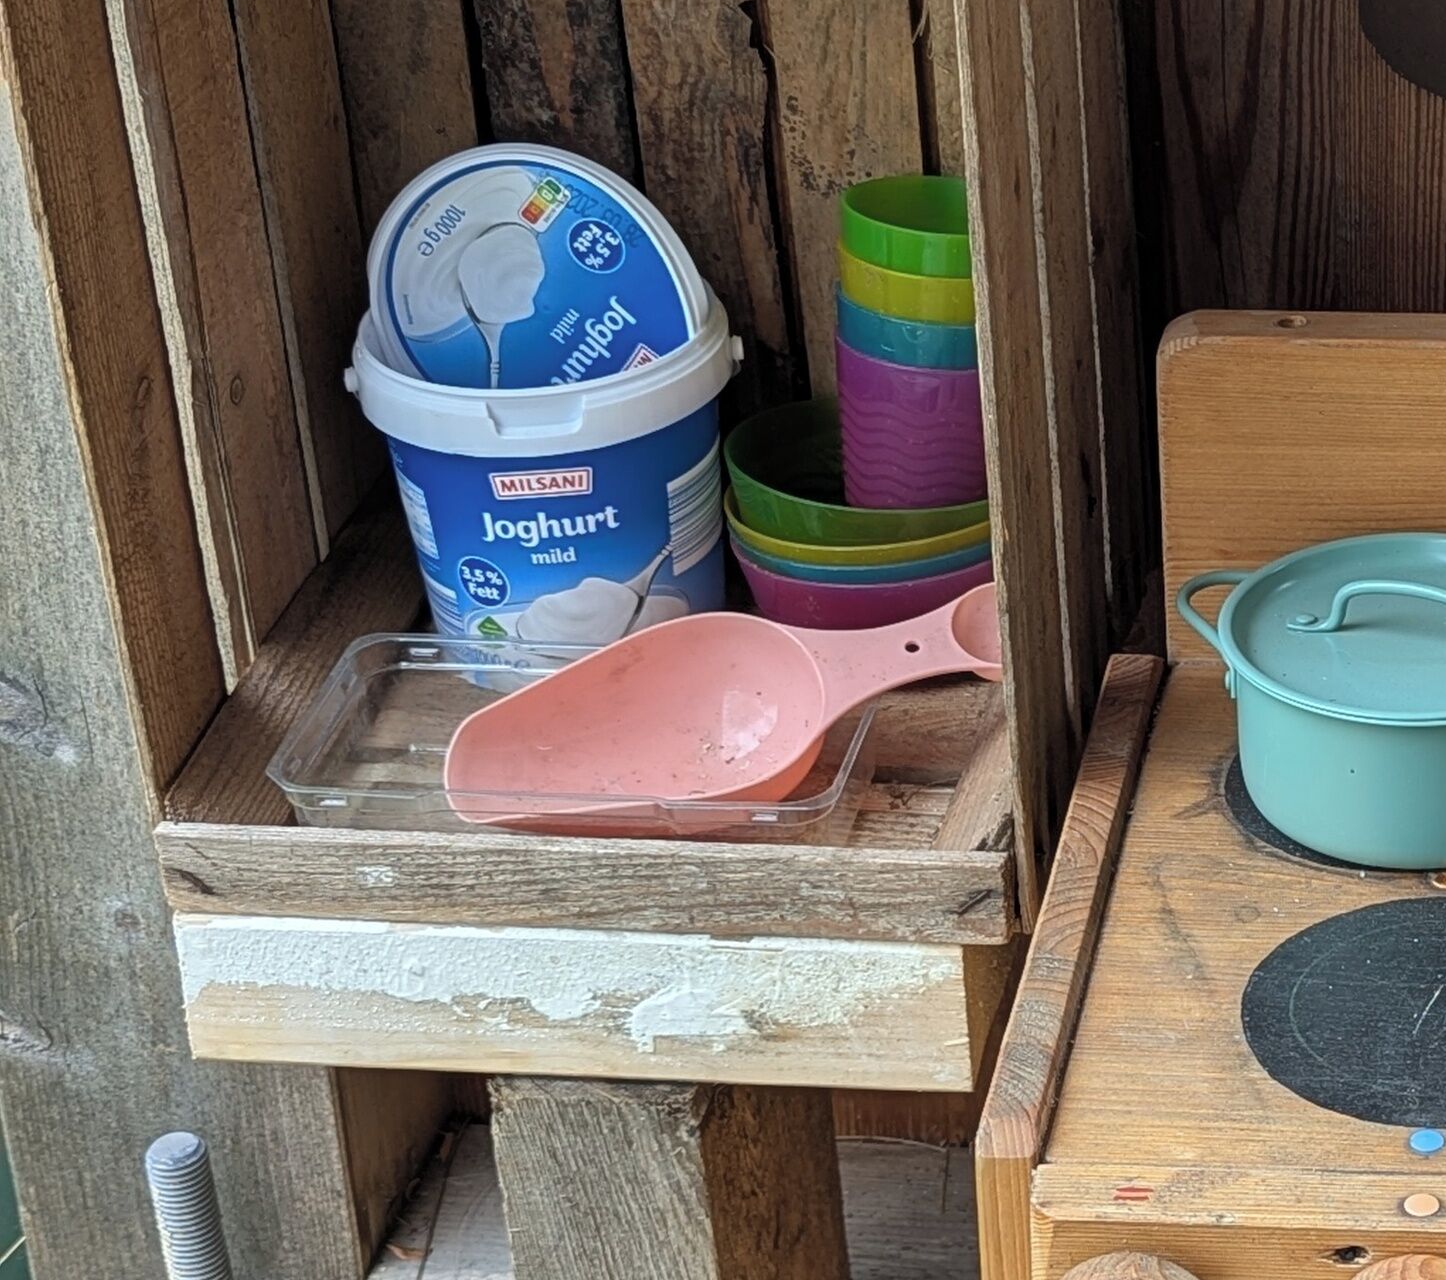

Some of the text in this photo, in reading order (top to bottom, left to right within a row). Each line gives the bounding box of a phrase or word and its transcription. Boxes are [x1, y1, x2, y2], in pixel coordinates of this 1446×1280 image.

[434, 204, 466, 235] 1000
[572, 223, 603, 253] Fett
[550, 308, 581, 344] mild
[500, 474, 584, 493] MILSANI
[482, 505, 620, 548] Joghurt
[530, 546, 577, 565] mild
[467, 582, 501, 601] Fett
